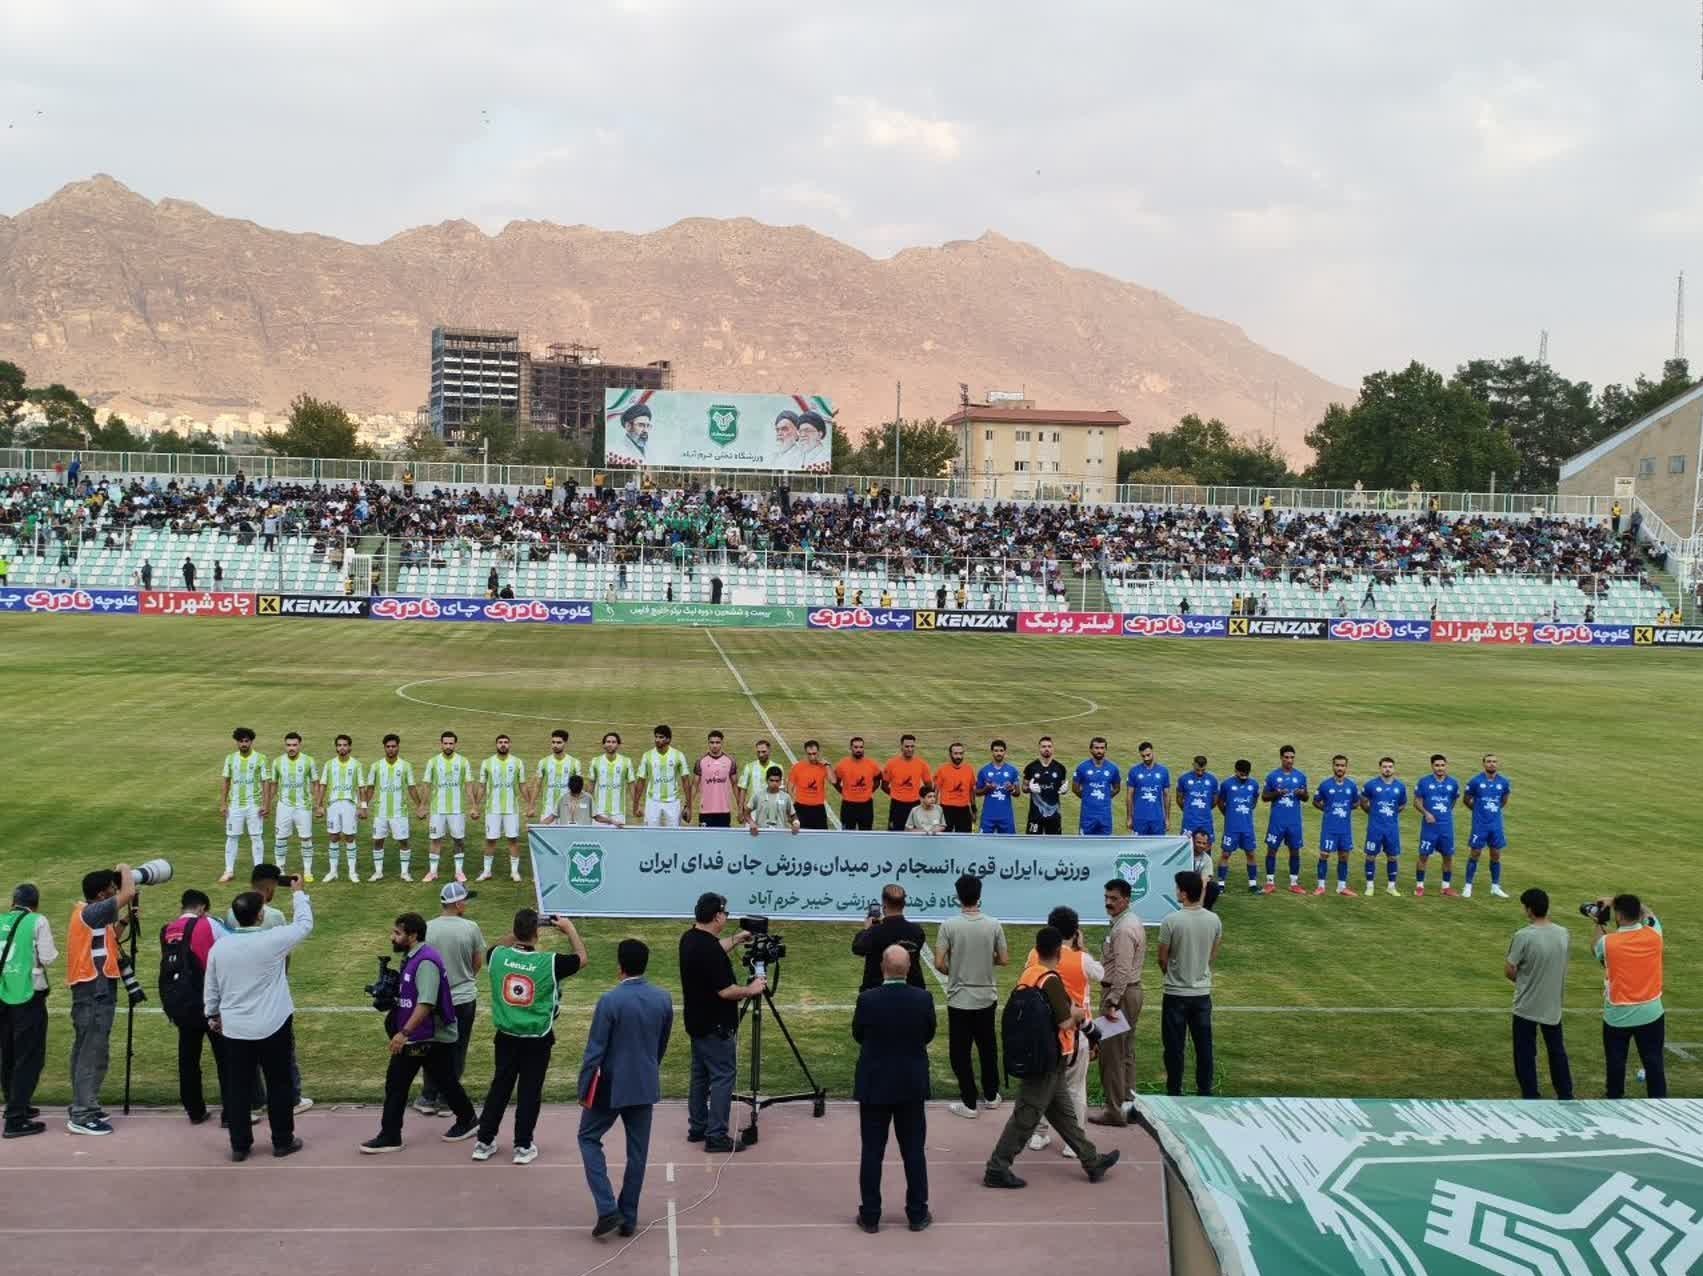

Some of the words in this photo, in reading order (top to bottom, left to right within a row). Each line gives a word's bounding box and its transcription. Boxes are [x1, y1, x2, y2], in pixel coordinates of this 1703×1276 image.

[24, 590, 94, 611] نادری
[95, 595, 138, 610] کلوچه
[144, 592, 214, 613] شهرزاد
[218, 593, 251, 615] چای
[281, 598, 363, 614] KENZAX
[371, 597, 441, 620] نادری
[442, 601, 481, 618] چای
[484, 600, 550, 622] نادری
[550, 605, 591, 620] کلوچه
[808, 607, 873, 628] نادری
[874, 611, 911, 628] چای
[936, 613, 1011, 628] KENZAX
[1025, 613, 1073, 633] یونیک
[1077, 614, 1115, 633] فیلتر
[1124, 615, 1186, 635] نادری
[1186, 619, 1225, 633] کلوچه
[1249, 621, 1322, 635] KENZAX
[1330, 619, 1393, 640] نادری
[1394, 623, 1430, 639] چای
[1435, 622, 1497, 641] شهرزاد
[1499, 622, 1529, 643] چای
[1533, 624, 1593, 645] نادری
[1593, 628, 1630, 642] کلوچه
[1654, 629, 1703, 643] KENZ
[639, 852, 678, 874] ایران
[681, 850, 724, 874] فدای
[727, 854, 762, 875] جان
[870, 860, 893, 878] در
[748, 889, 773, 908] آباد
[774, 891, 800, 911] خرم
[801, 892, 833, 910] خیبر
[904, 892, 937, 912] فرهن
[503, 958, 537, 972] Lenz.ir
